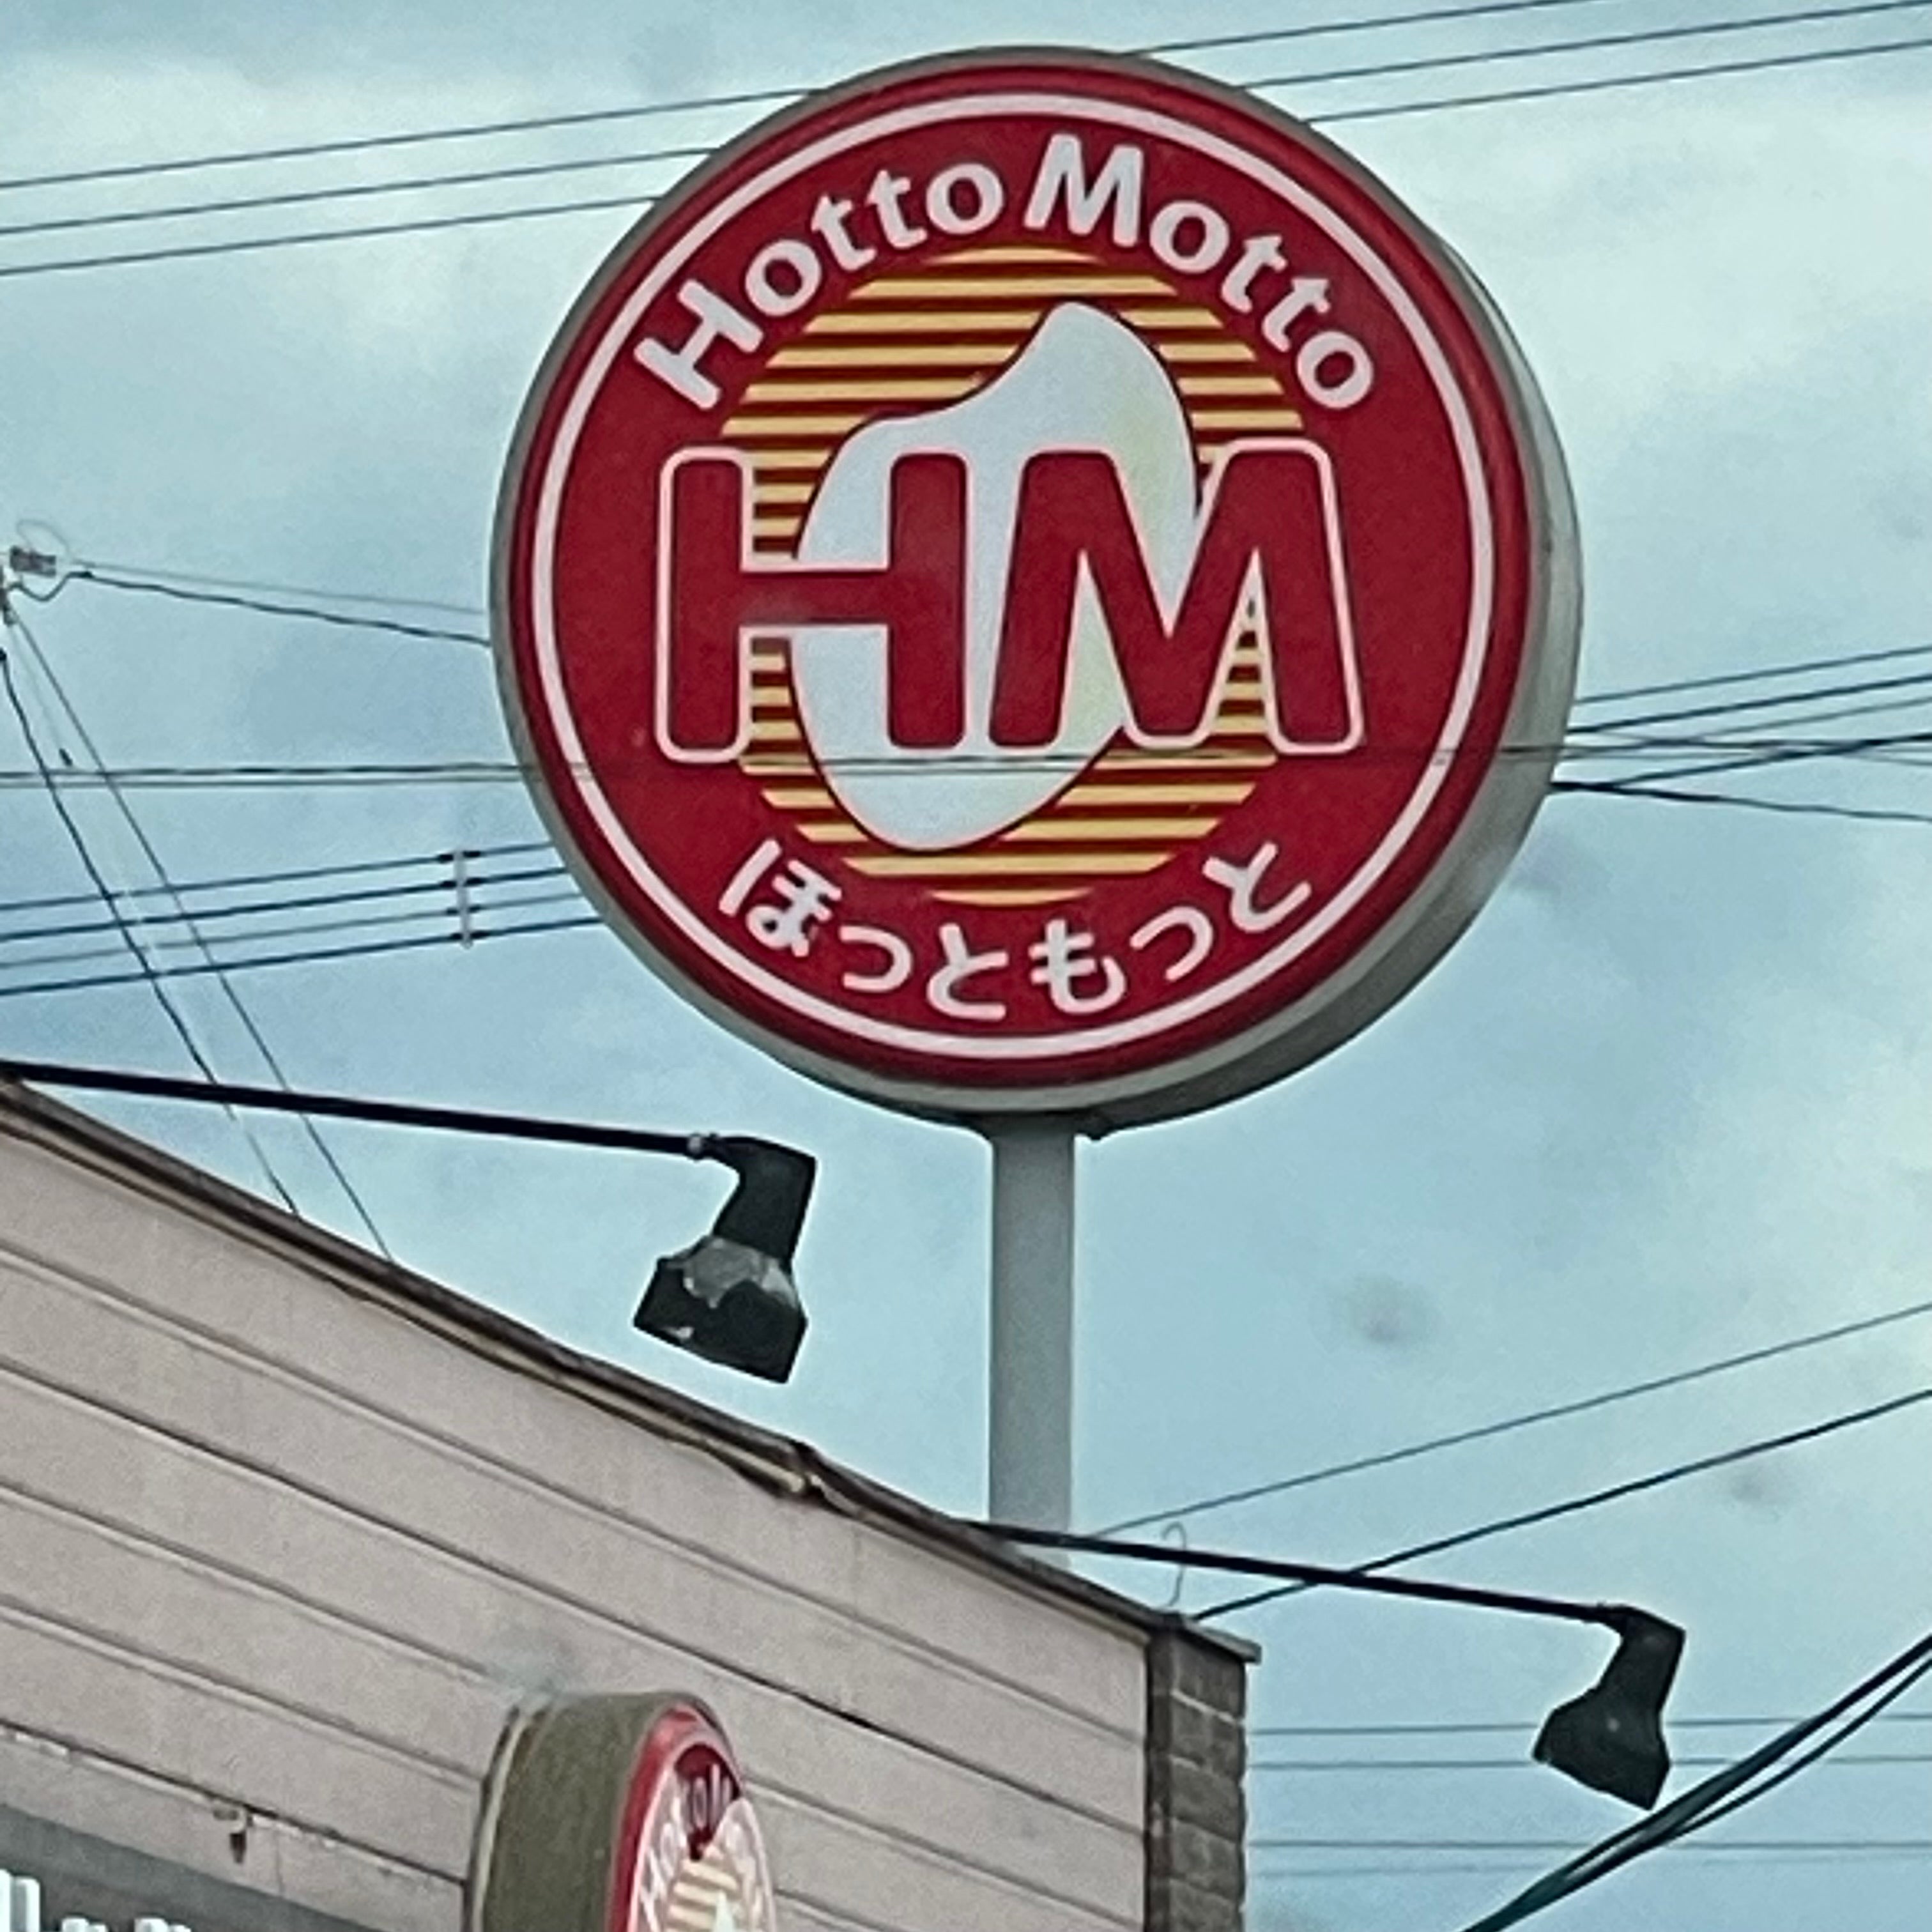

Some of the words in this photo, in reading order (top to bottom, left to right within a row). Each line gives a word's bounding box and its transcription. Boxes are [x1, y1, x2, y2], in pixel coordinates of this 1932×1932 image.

[634, 161, 1005, 411] Hotto
[1023, 133, 1376, 410] Motto
[654, 437, 1365, 763] HM
[719, 839, 1311, 1020] ほっともっと
